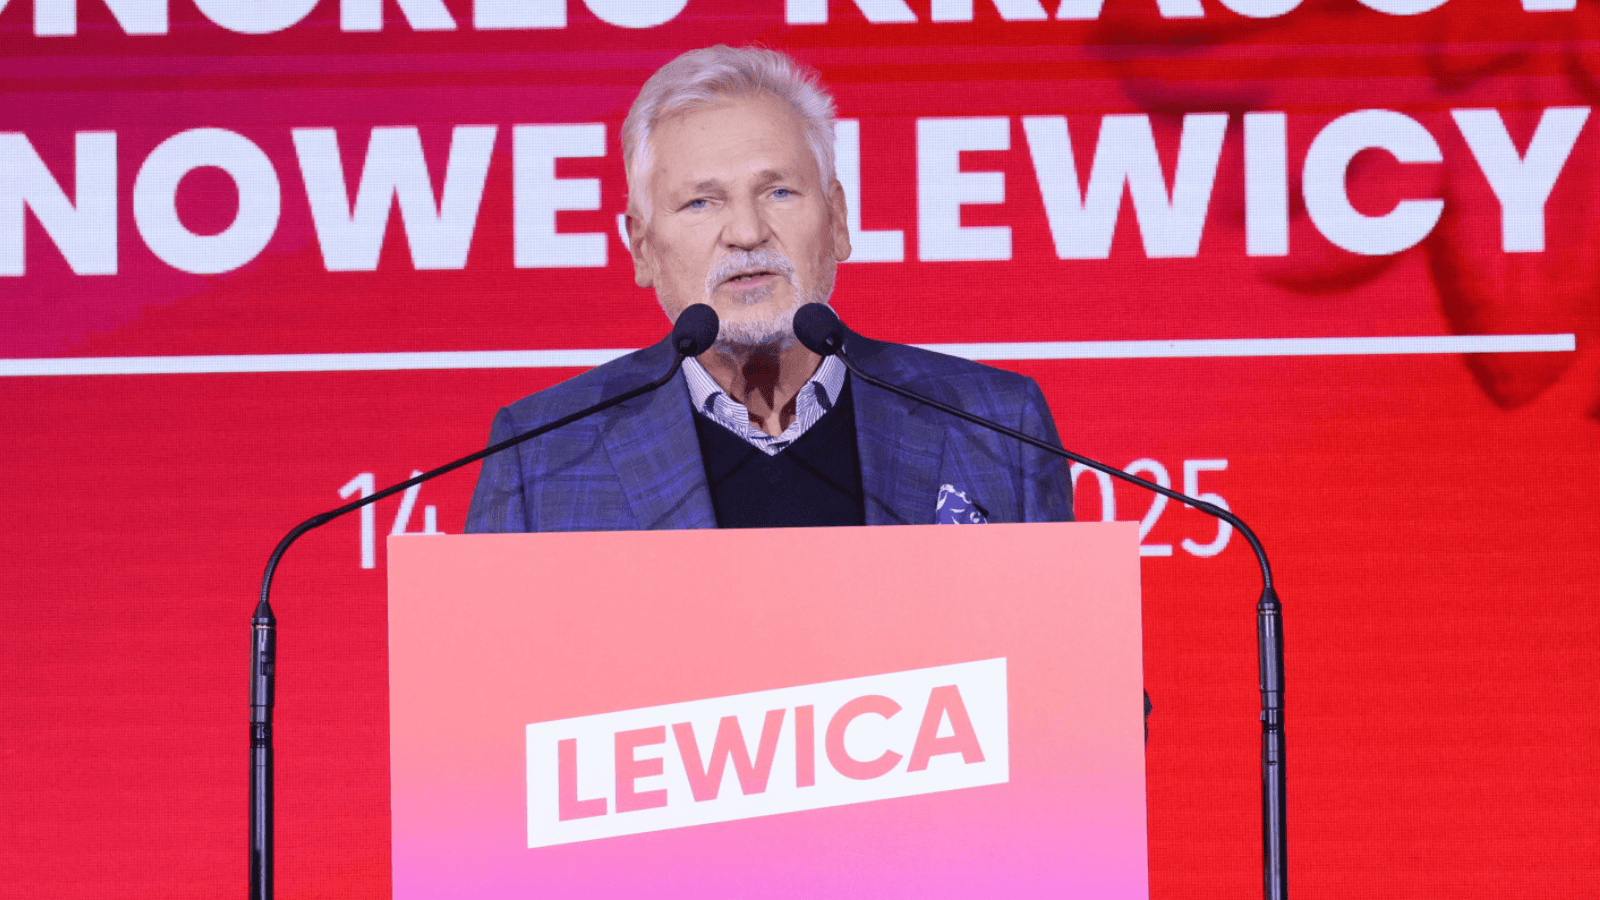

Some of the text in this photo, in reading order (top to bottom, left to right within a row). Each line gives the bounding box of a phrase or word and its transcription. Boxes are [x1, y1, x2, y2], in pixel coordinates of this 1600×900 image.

[0, 106, 1592, 276] NOWE LEWICY
[337, 457, 1234, 569] 14 025
[557, 684, 986, 822] LEWICA
